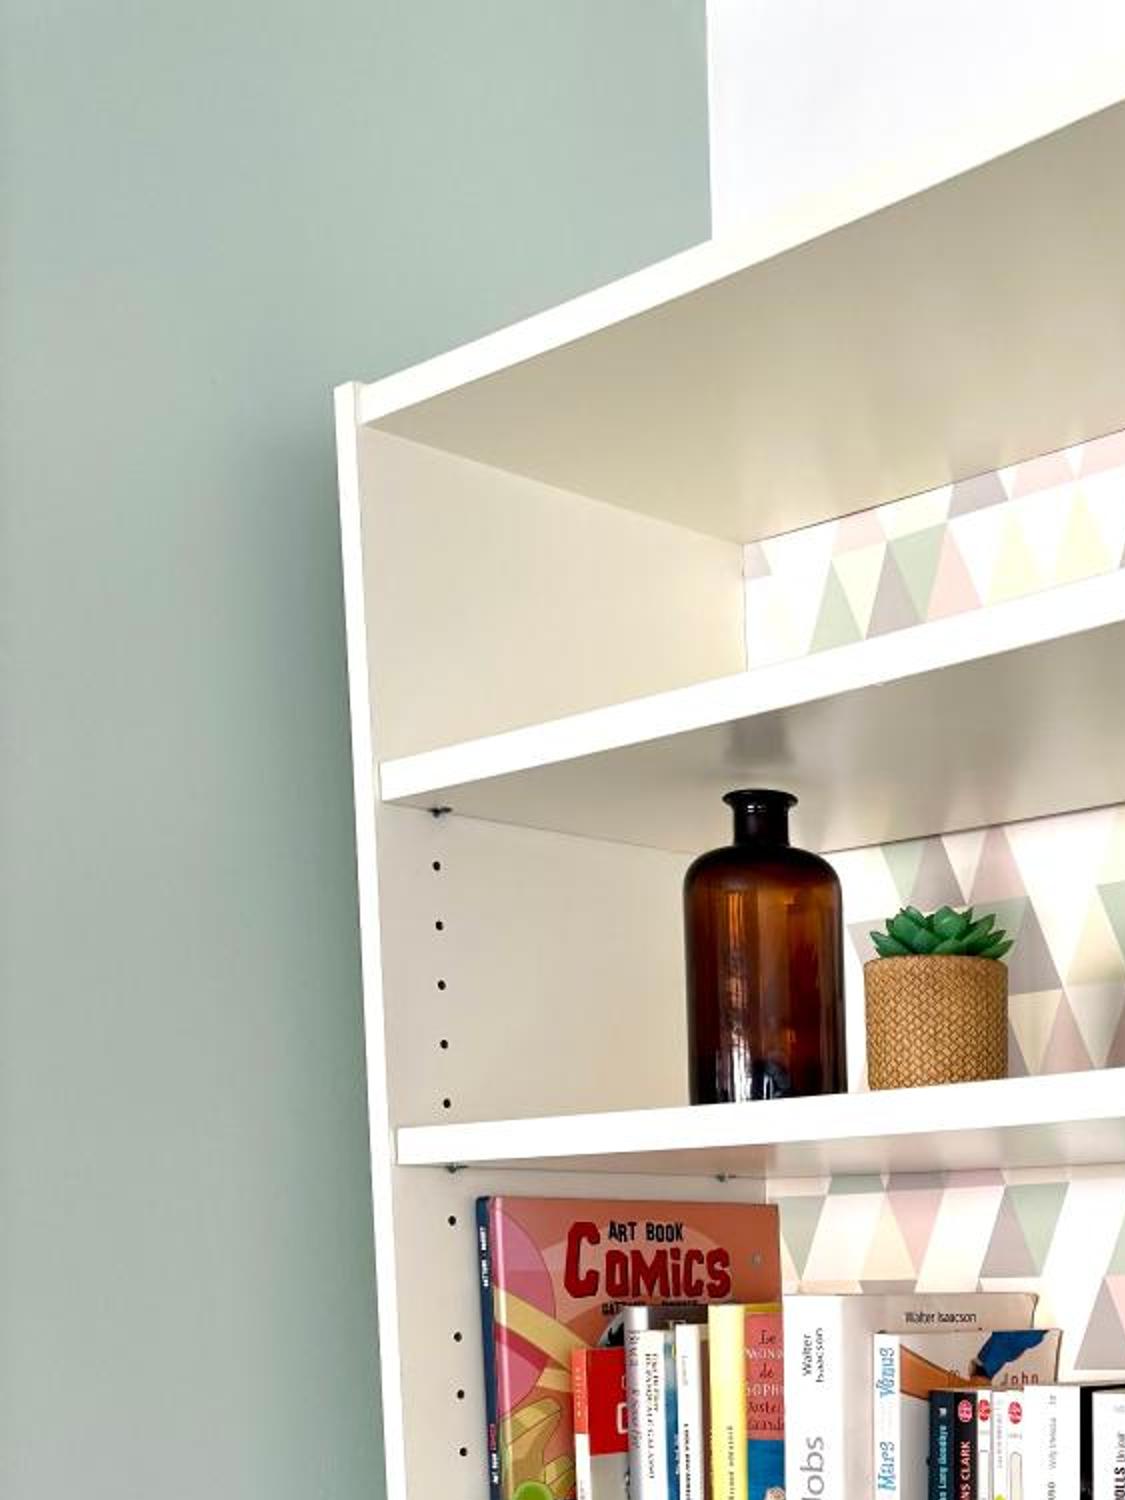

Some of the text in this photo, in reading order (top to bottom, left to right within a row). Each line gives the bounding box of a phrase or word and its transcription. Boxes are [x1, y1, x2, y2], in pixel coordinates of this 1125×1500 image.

[608, 1220, 684, 1242] ART BOOK
[905, 1311, 977, 1324] Walter Isaacson
[802, 1331, 812, 1378] Walter
[815, 1327, 825, 1384] Isaacson
[1001, 1372, 1039, 1387] John
[960, 1441, 972, 1480] CLARK
